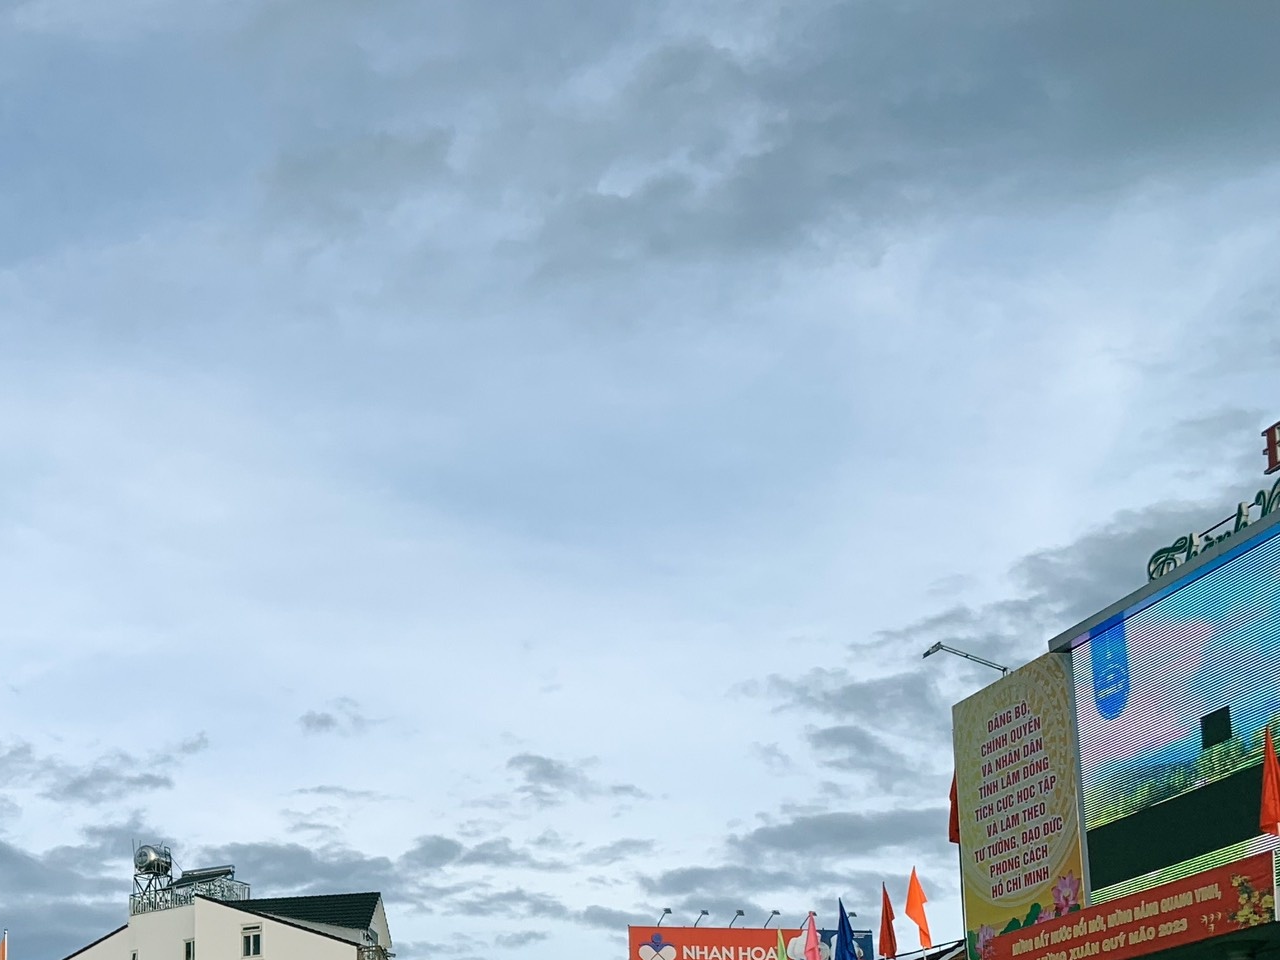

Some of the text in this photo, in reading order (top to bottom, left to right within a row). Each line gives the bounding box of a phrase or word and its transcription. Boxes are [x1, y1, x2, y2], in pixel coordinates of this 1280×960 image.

[981, 716, 1041, 757] CHÍNH QUYỀN
[978, 756, 1049, 800] TỈNH LÂM ĐỒNG
[981, 737, 1043, 778] VÀ NHÂN DÂN
[975, 775, 1056, 822] TÍCH CỰC HỌC TẬP
[974, 847, 986, 863] TƯ
[1022, 826, 1040, 845] ĐẠO
[1043, 816, 1063, 836] ĐỨC
[986, 802, 1046, 838] VÀ LÀM THEO
[990, 844, 1048, 878] PHONG CÁCH
[991, 866, 1049, 899] HỒ CHÍ MINH
[1069, 942, 1100, 960] XUÂN
[1102, 932, 1126, 952] QUÝ
[1128, 926, 1156, 945] MÃO
[1158, 918, 1188, 938] 2023
